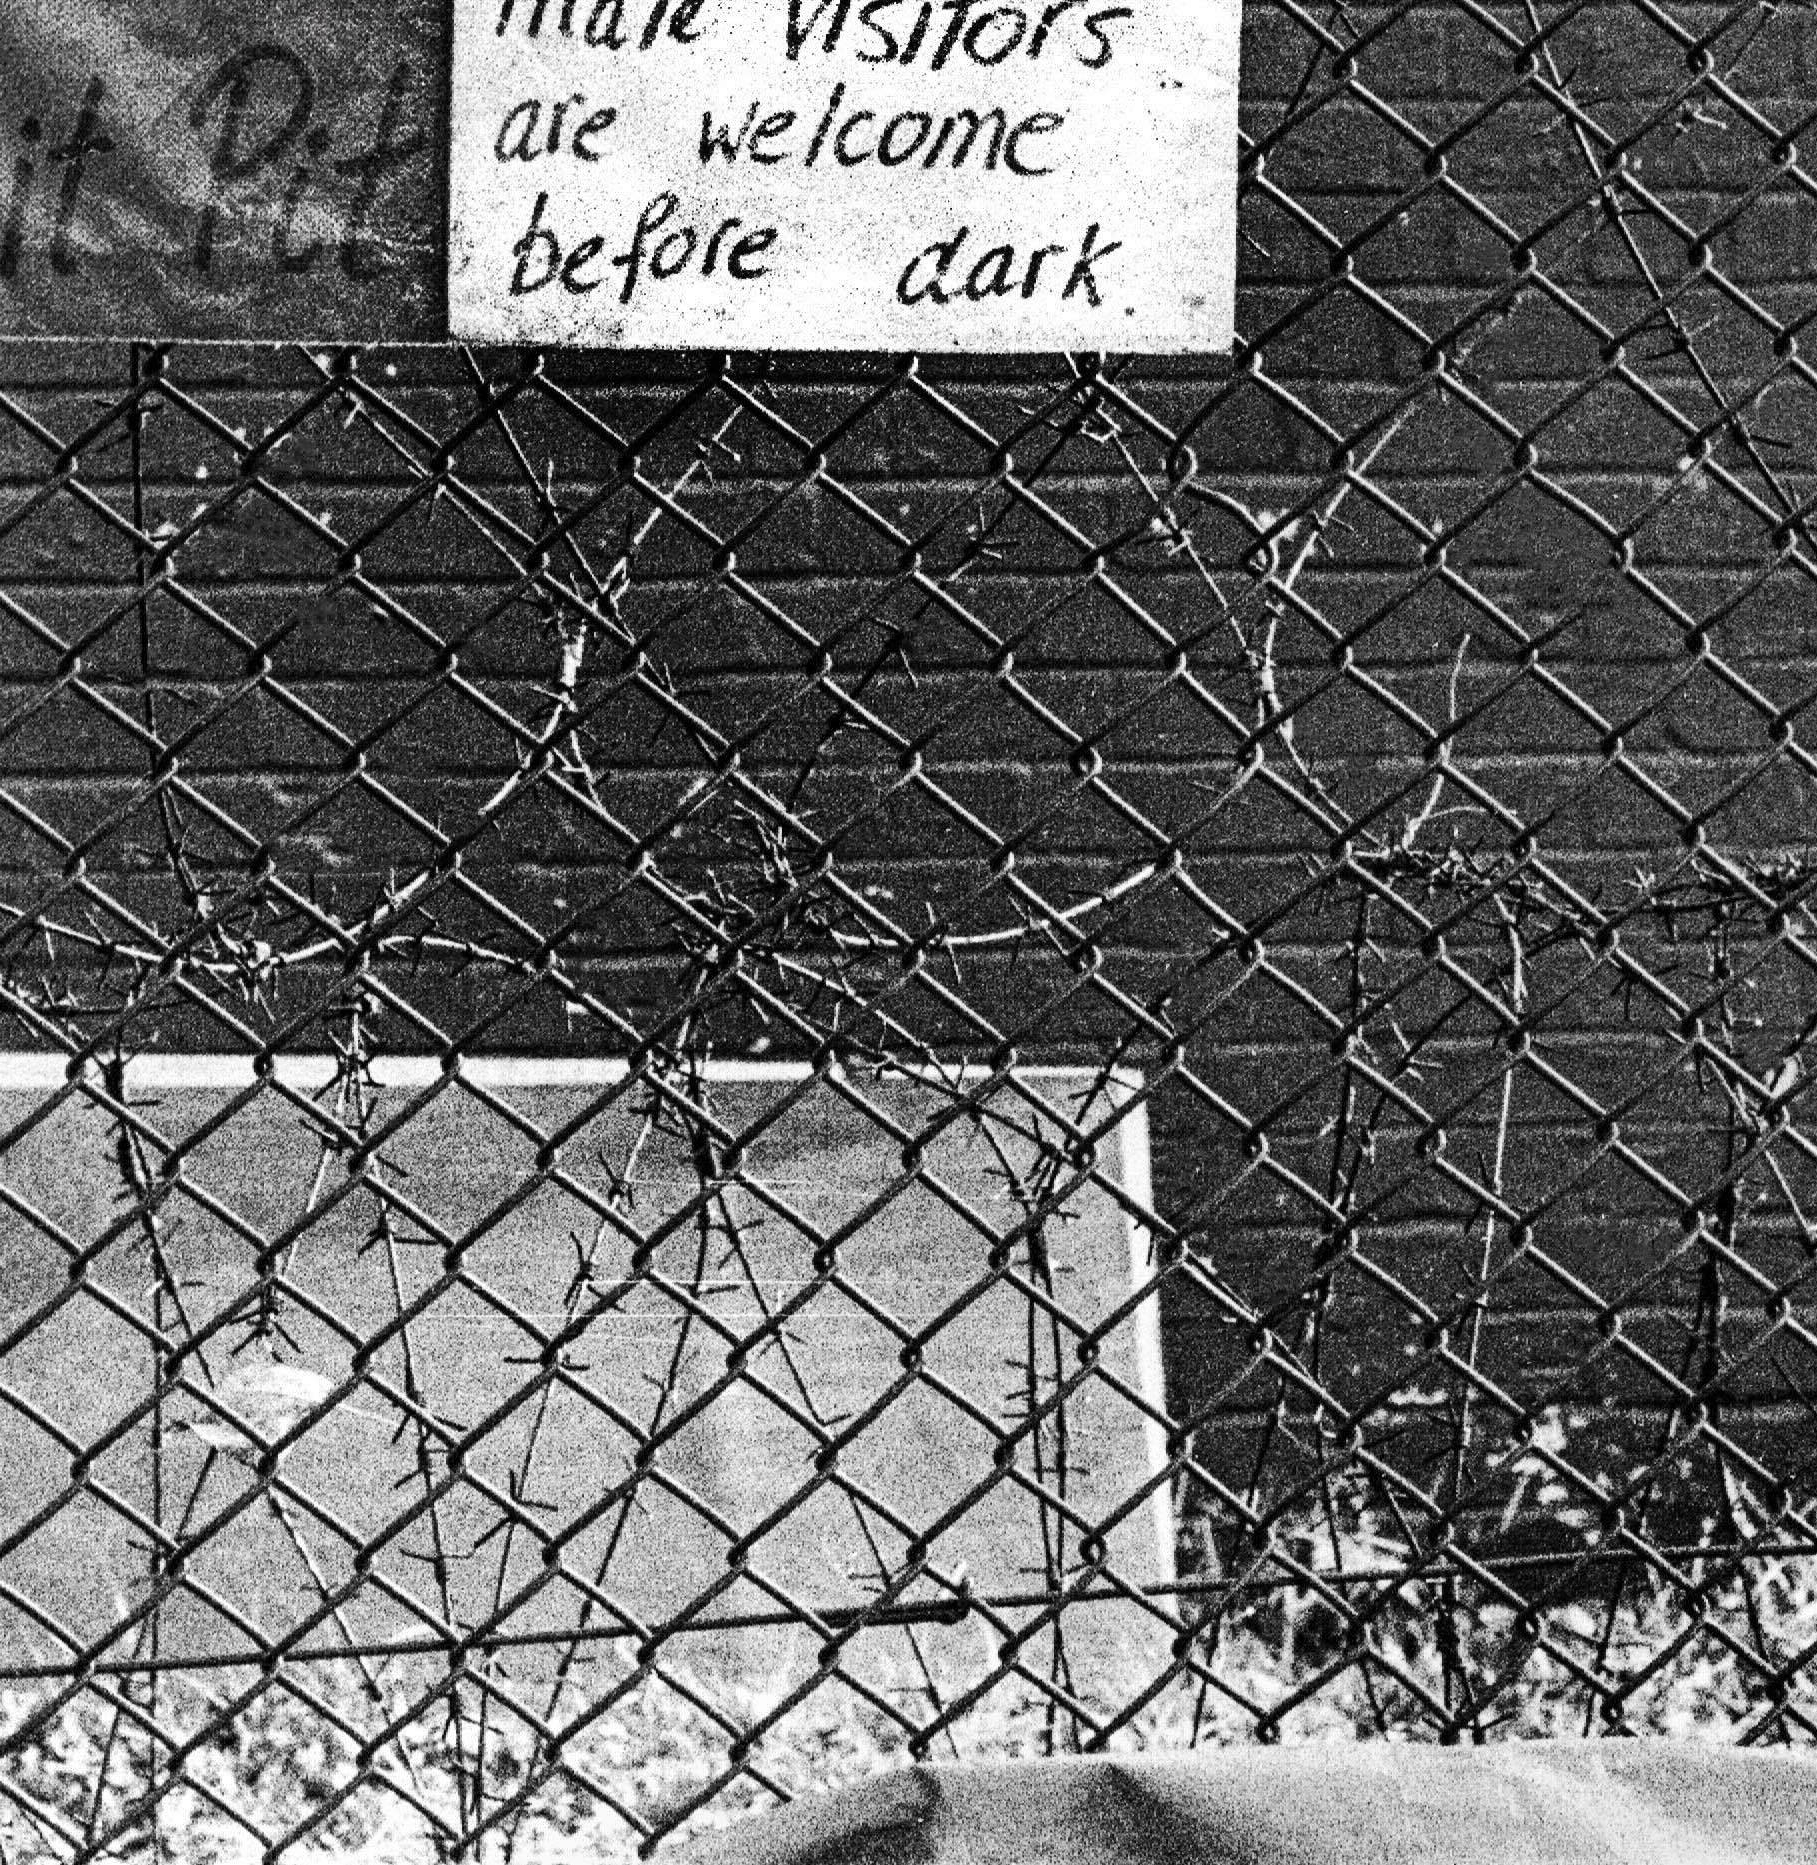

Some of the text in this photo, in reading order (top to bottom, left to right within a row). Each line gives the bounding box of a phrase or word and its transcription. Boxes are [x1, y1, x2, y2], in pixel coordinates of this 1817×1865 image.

[494, 82, 1066, 177] are welcome
[509, 191, 780, 304] before
